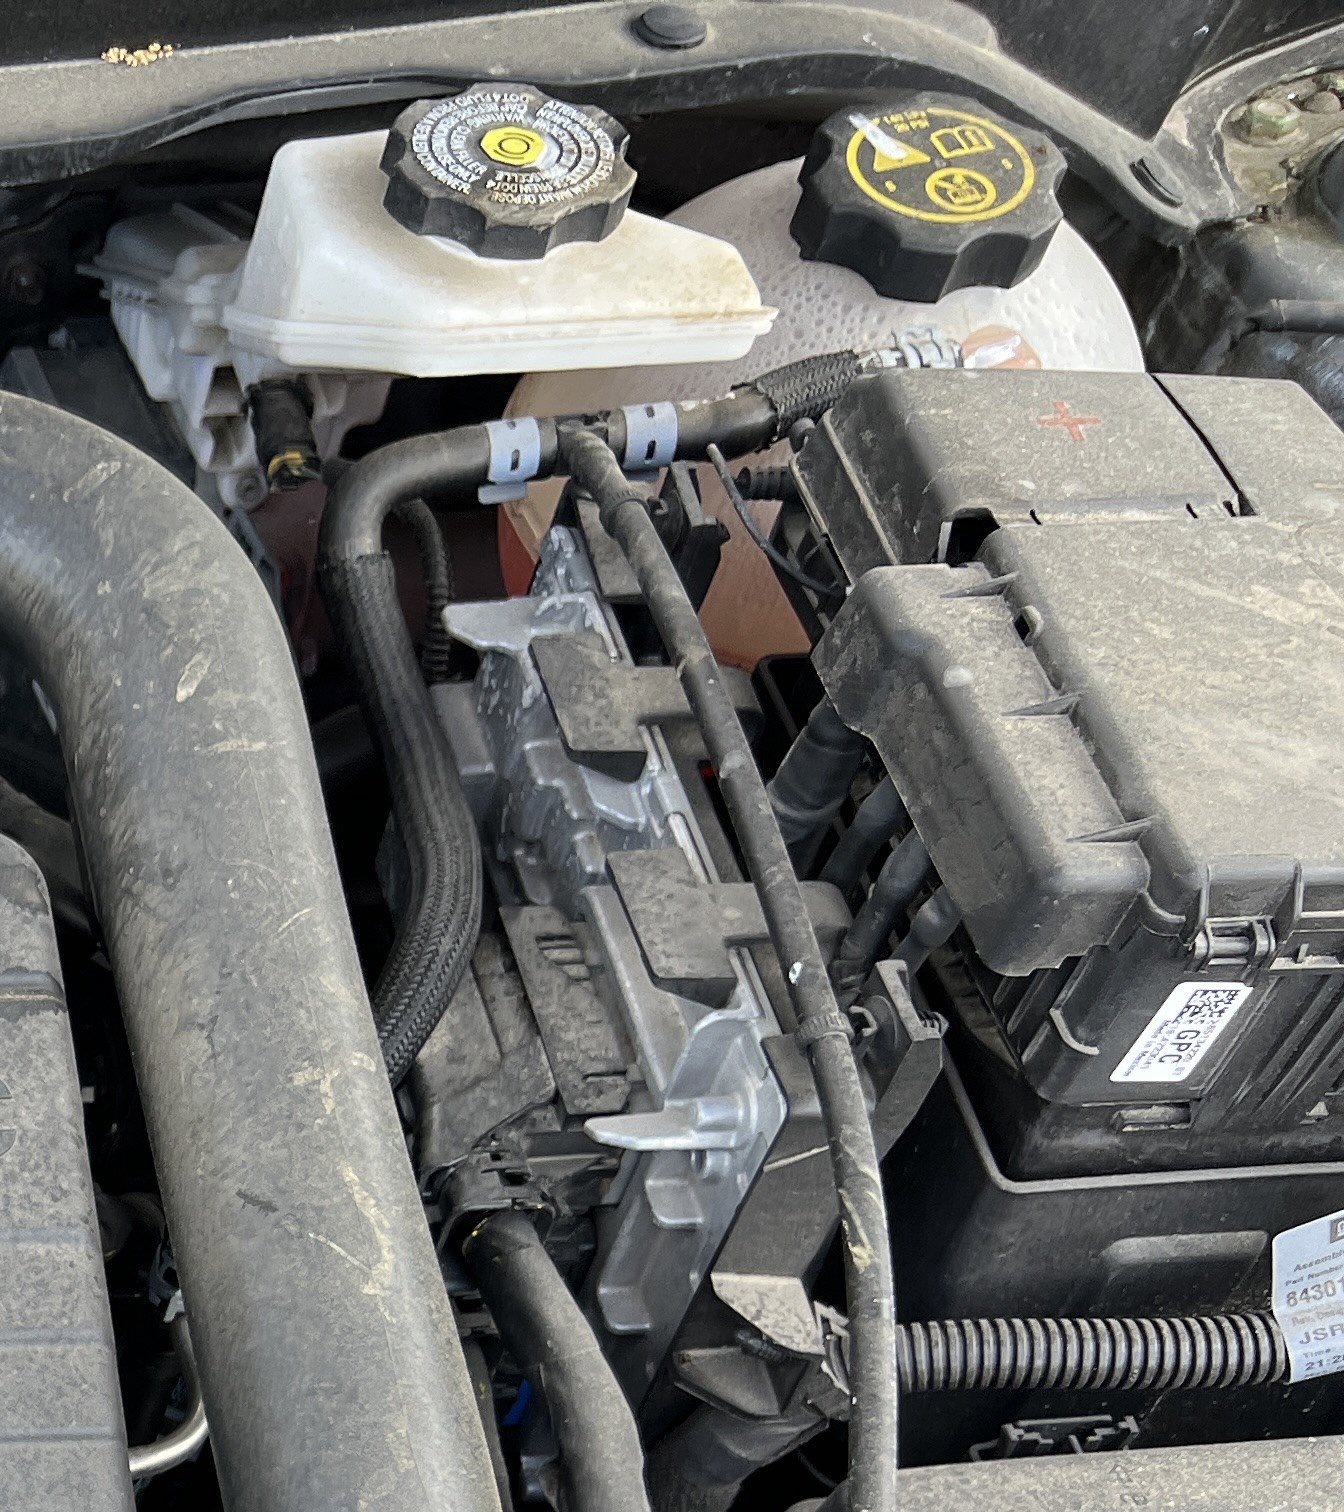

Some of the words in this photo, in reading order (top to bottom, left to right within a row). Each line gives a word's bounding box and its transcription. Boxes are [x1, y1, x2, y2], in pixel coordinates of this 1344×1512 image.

[1158, 1029, 1201, 1064] GPC
[1293, 1249, 1344, 1272] Assembl
[1304, 1354, 1344, 1371] 21:2
